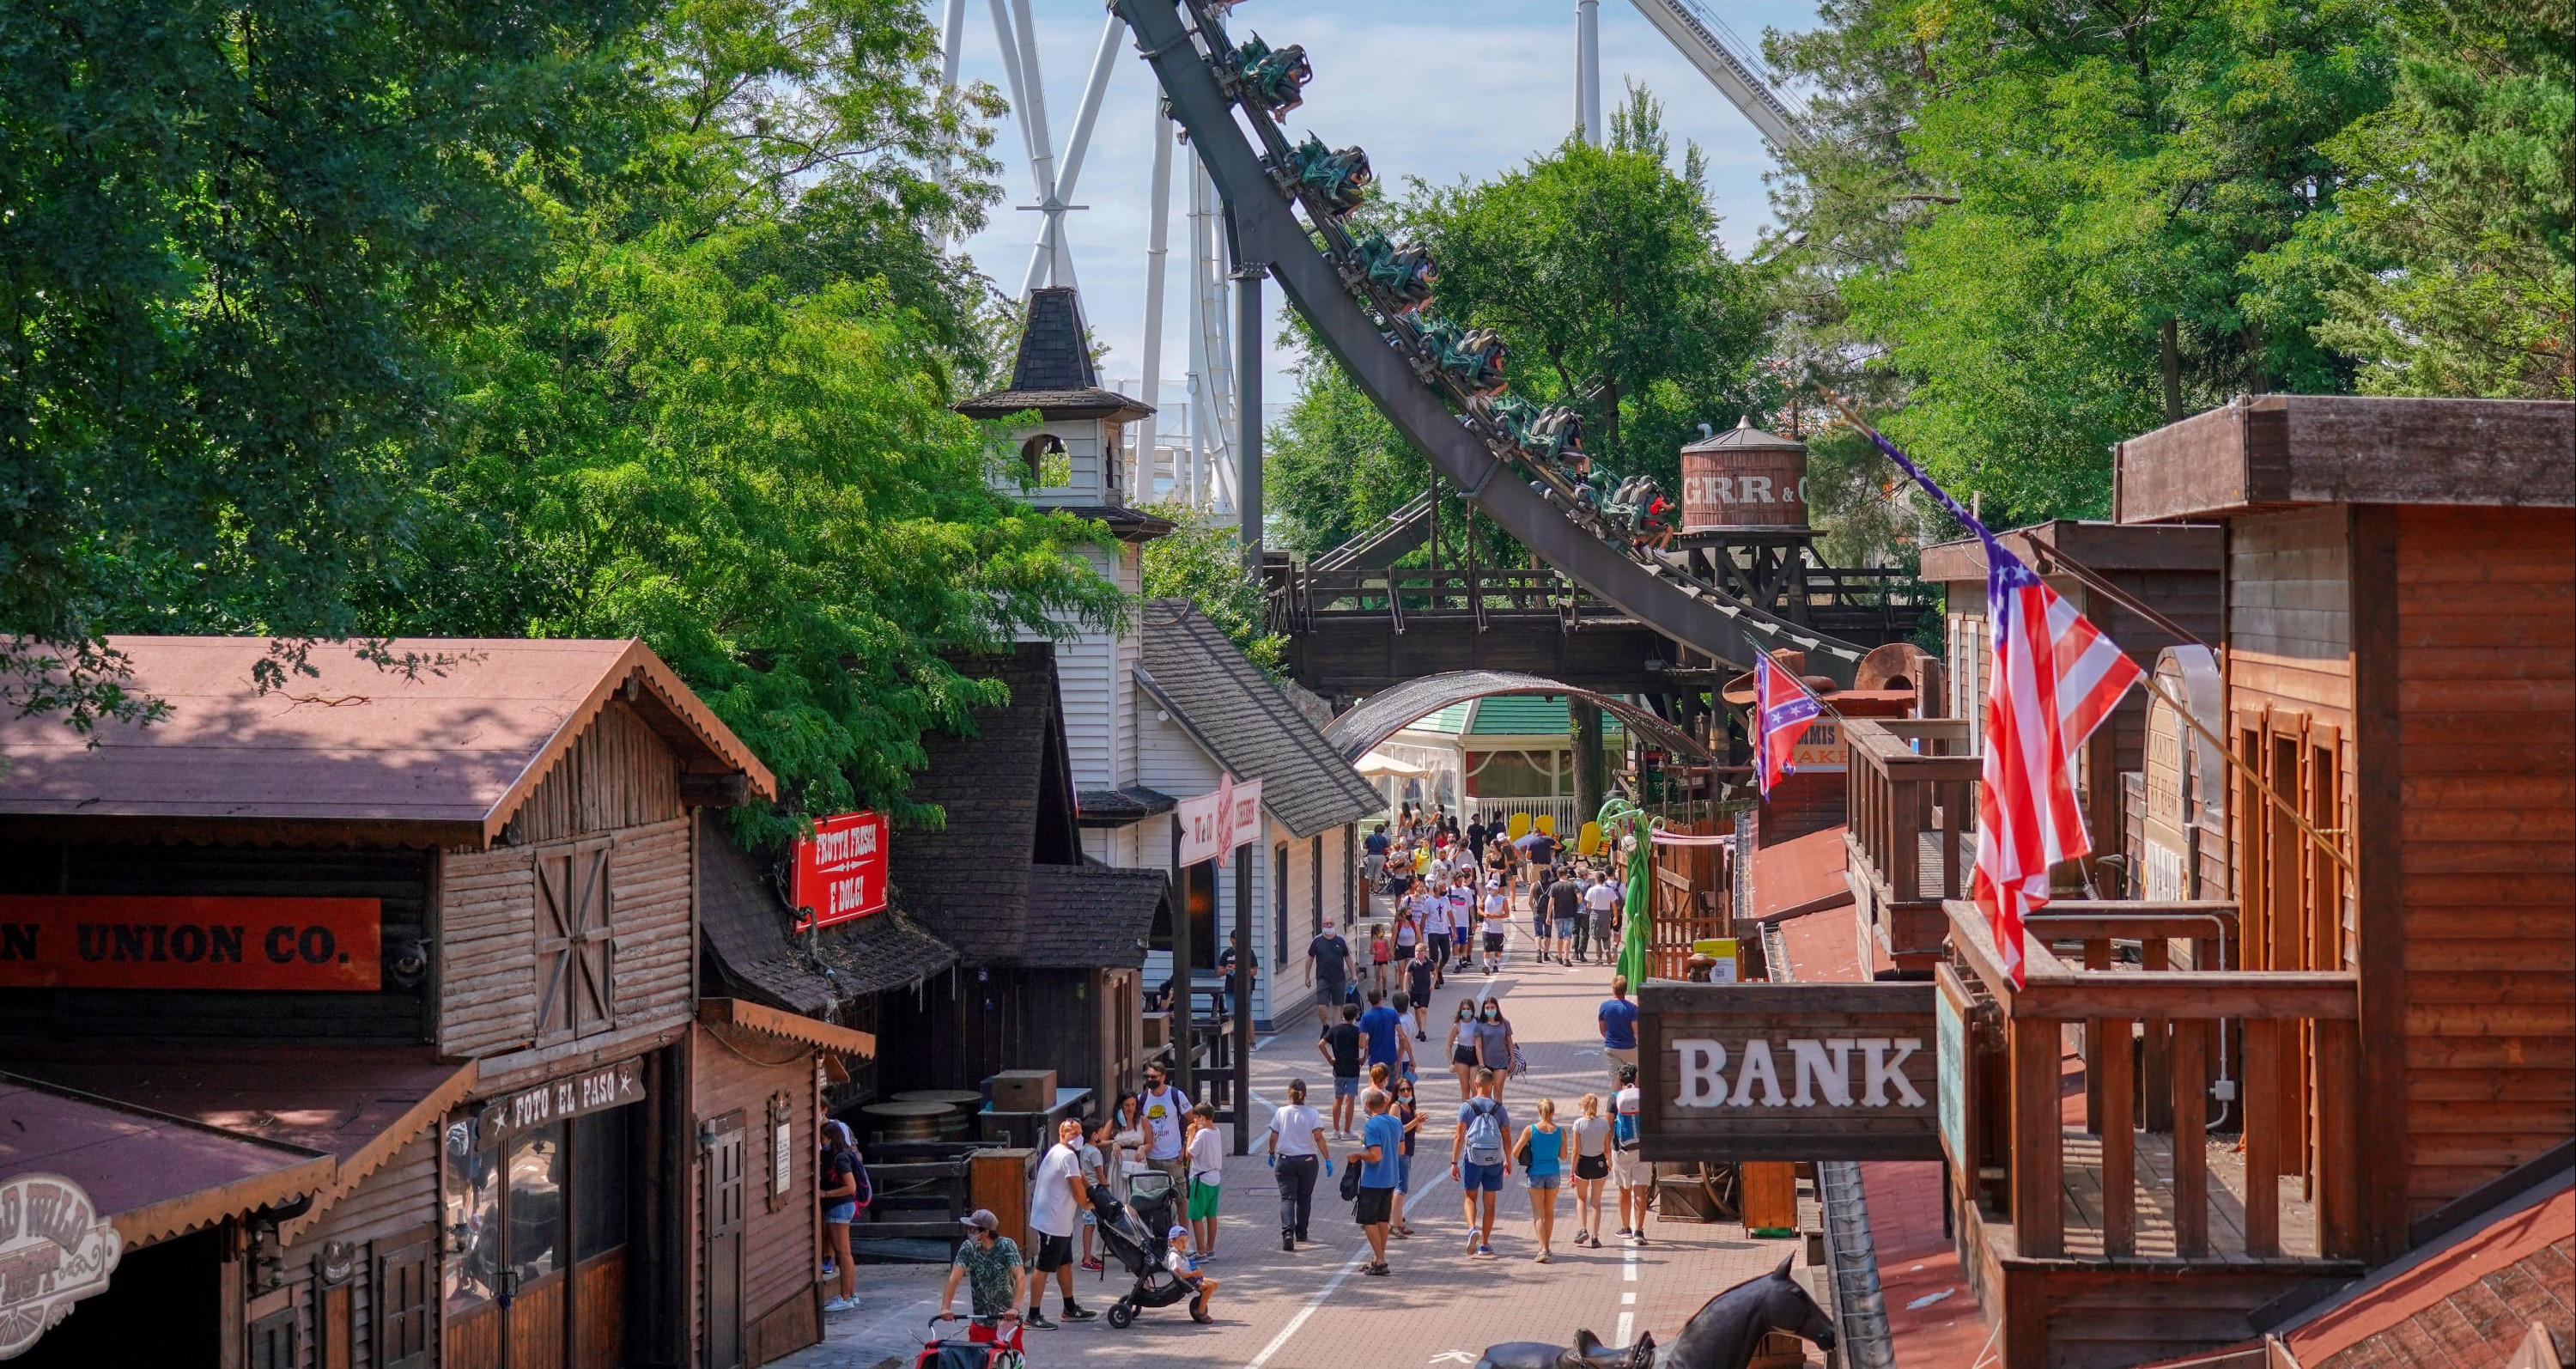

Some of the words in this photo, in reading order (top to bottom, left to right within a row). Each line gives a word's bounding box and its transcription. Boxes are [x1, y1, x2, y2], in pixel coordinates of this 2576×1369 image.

[1684, 476, 1775, 505] GRR
[1783, 487, 1795, 502] &
[816, 830, 849, 865] FRUTTA
[850, 824, 877, 858] FRESCA
[829, 881, 837, 915] E
[839, 875, 864, 912] DOLCI
[76, 924, 245, 964] UNION
[264, 926, 349, 964] CO.
[1672, 1038, 1926, 1108] BANK
[515, 1088, 550, 1129] FOTO
[558, 1083, 575, 1114] EL
[583, 1071, 615, 1108] PASO
[27, 1183, 88, 1256] WILD
[0, 1245, 60, 1304] EST
